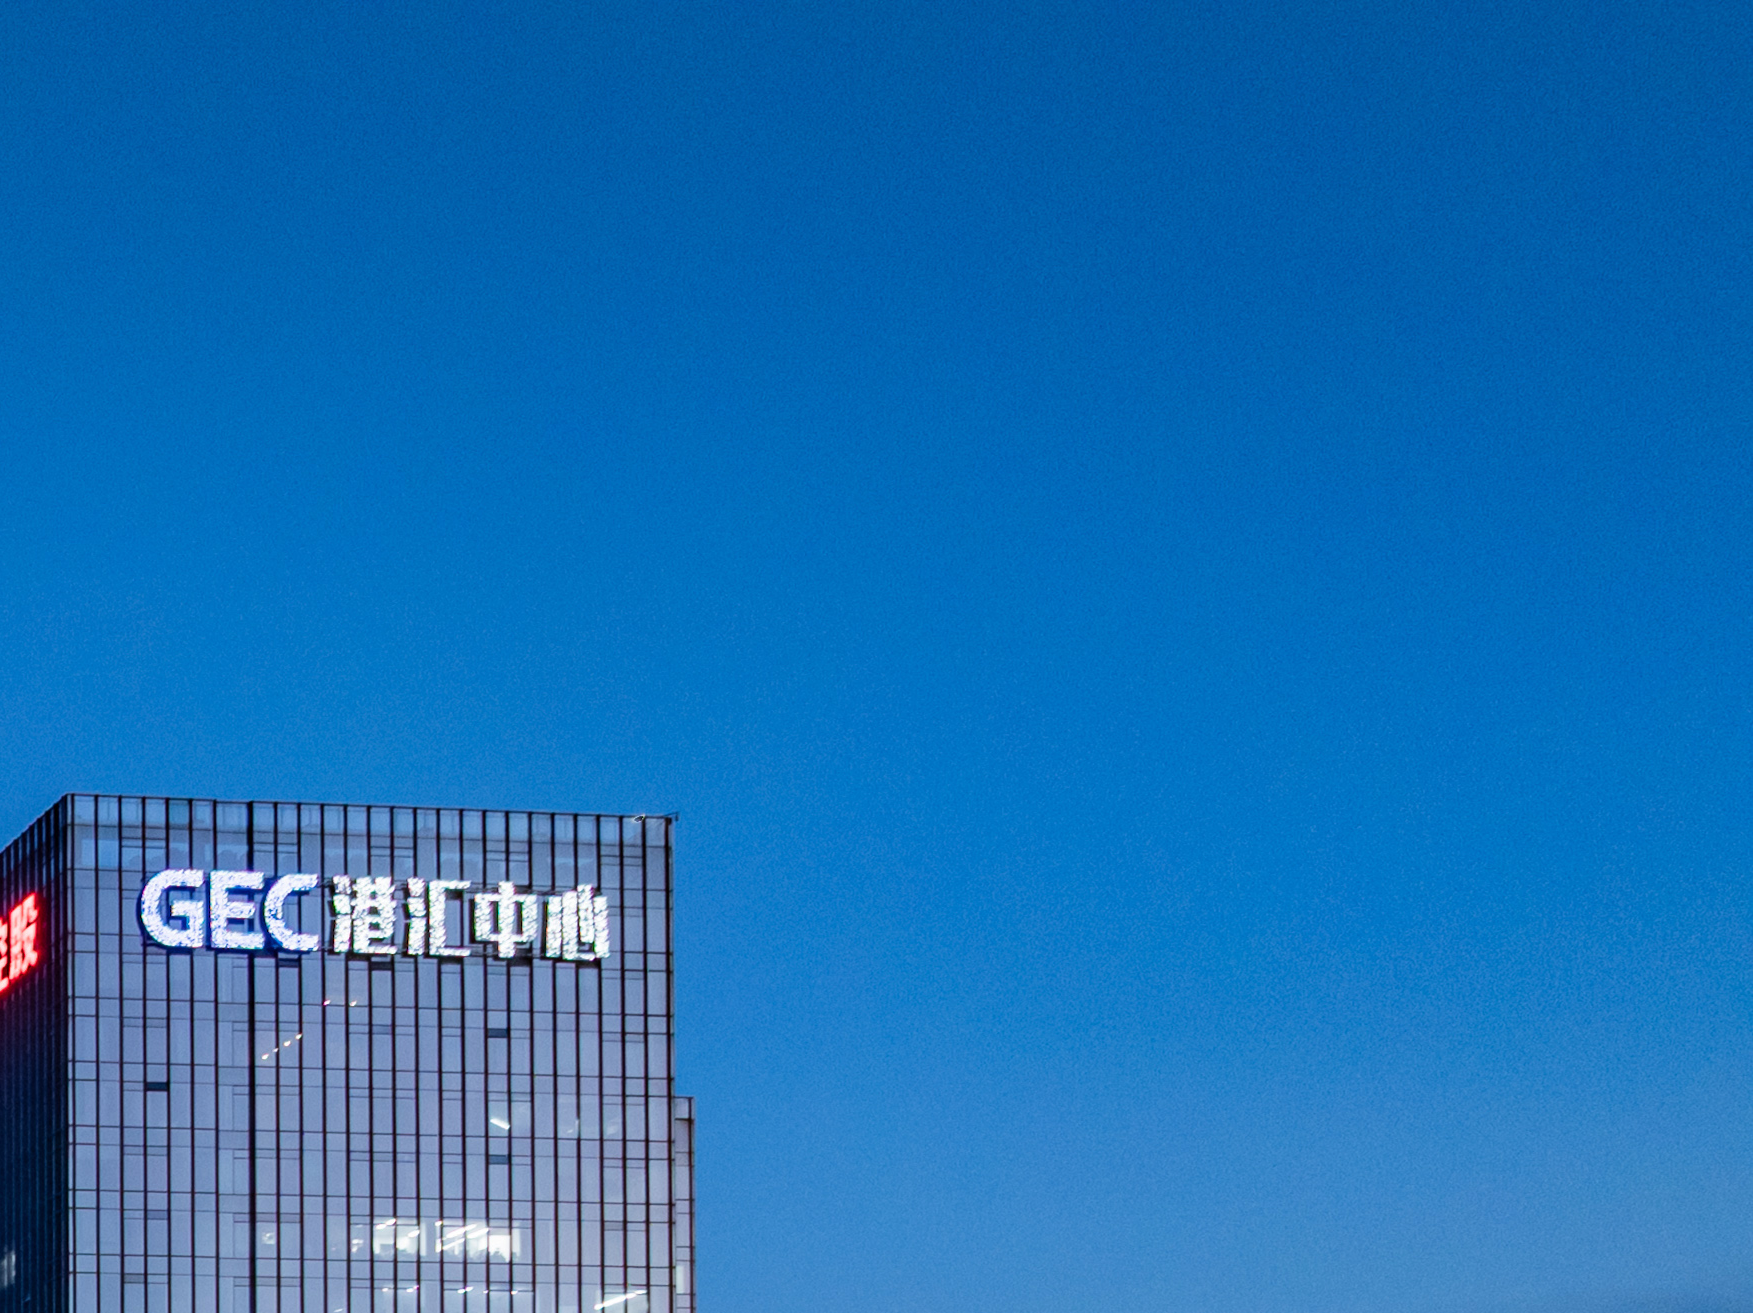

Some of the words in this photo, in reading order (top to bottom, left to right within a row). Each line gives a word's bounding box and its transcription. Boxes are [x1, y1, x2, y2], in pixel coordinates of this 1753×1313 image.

[140, 868, 319, 952] GEC
[331, 873, 611, 961] 港汇中心
